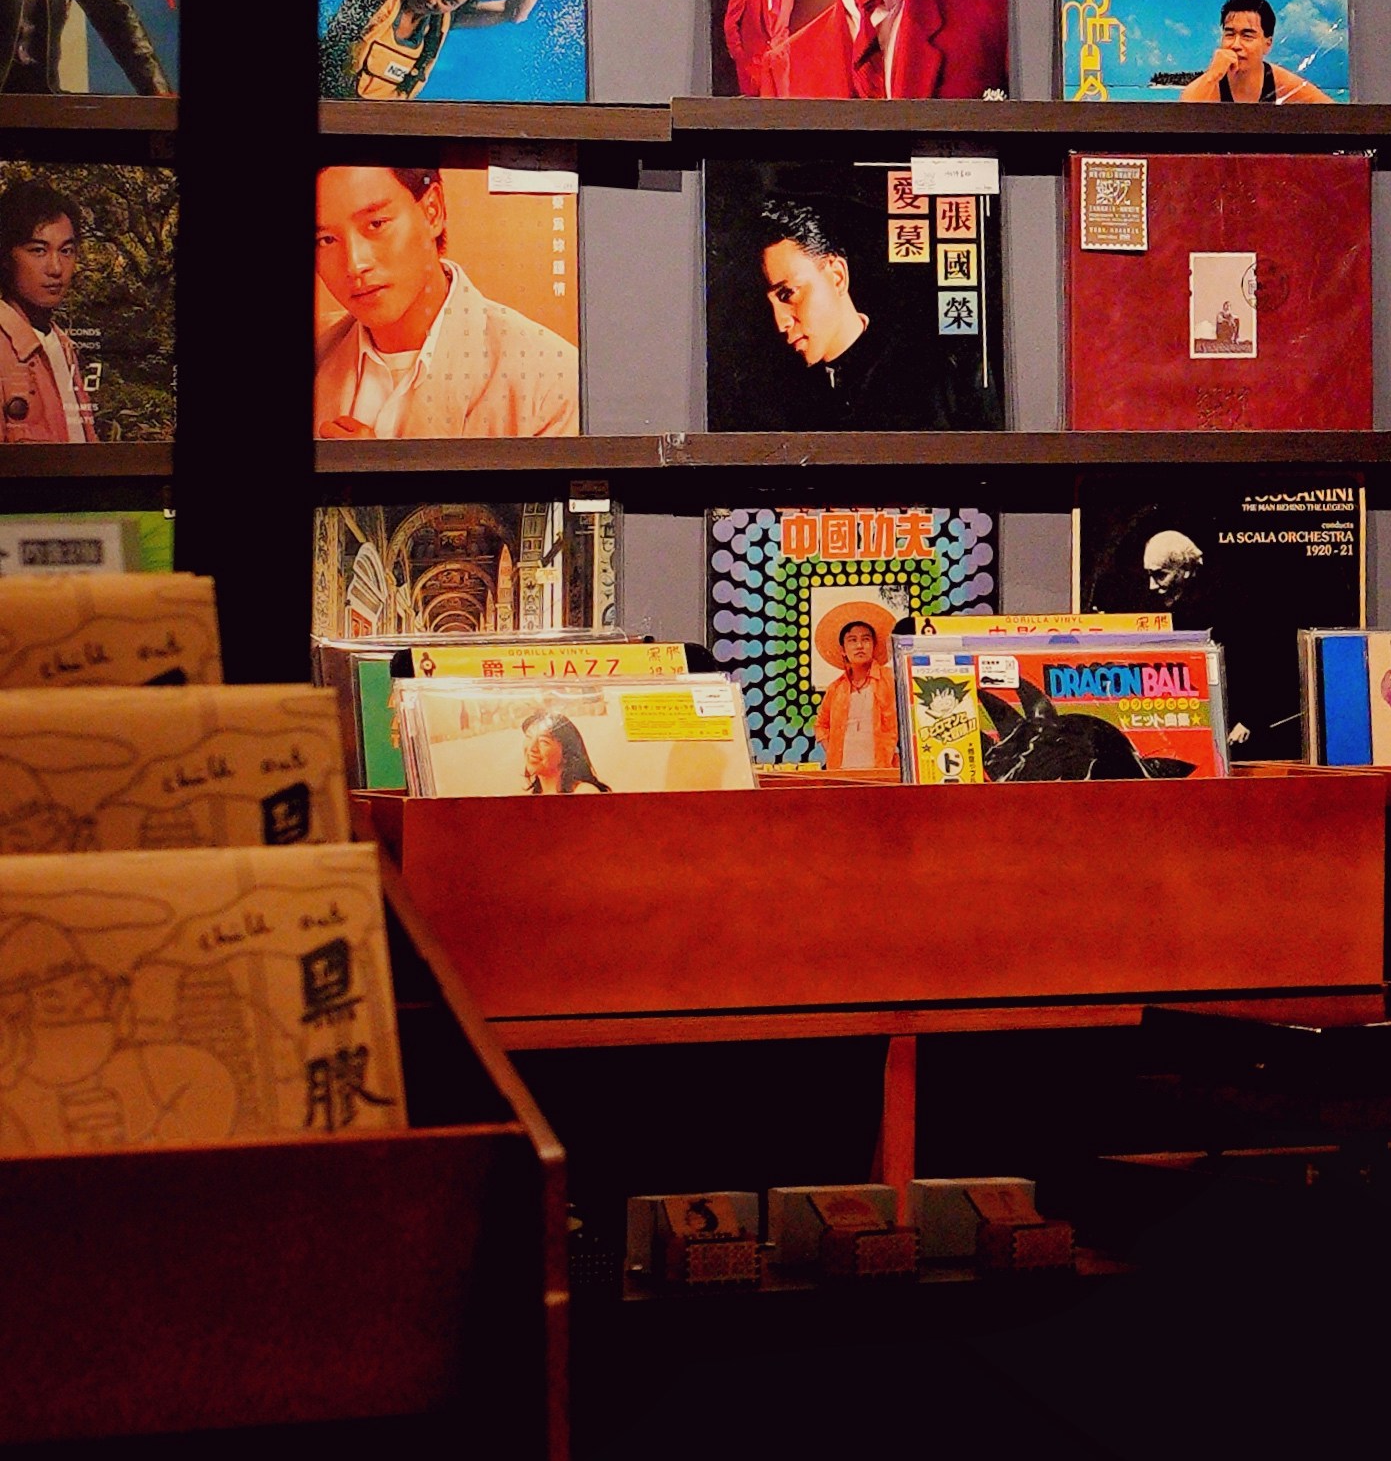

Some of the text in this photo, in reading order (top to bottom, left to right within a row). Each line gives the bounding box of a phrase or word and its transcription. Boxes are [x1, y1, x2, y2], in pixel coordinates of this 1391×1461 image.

[940, 200, 976, 331] 張國榮
[1256, 503, 1274, 512] MAN
[1276, 503, 1304, 512] BEHIND
[1319, 504, 1354, 512] LEGEND
[781, 511, 935, 560] 中國功夫
[1218, 531, 1354, 544] LA SCALA ORCHESTRA
[1005, 616, 1084, 625] GORILLA VINYL
[508, 647, 592, 657] GORILLA VINYL
[1049, 664, 1200, 698] DRAGON BALL
